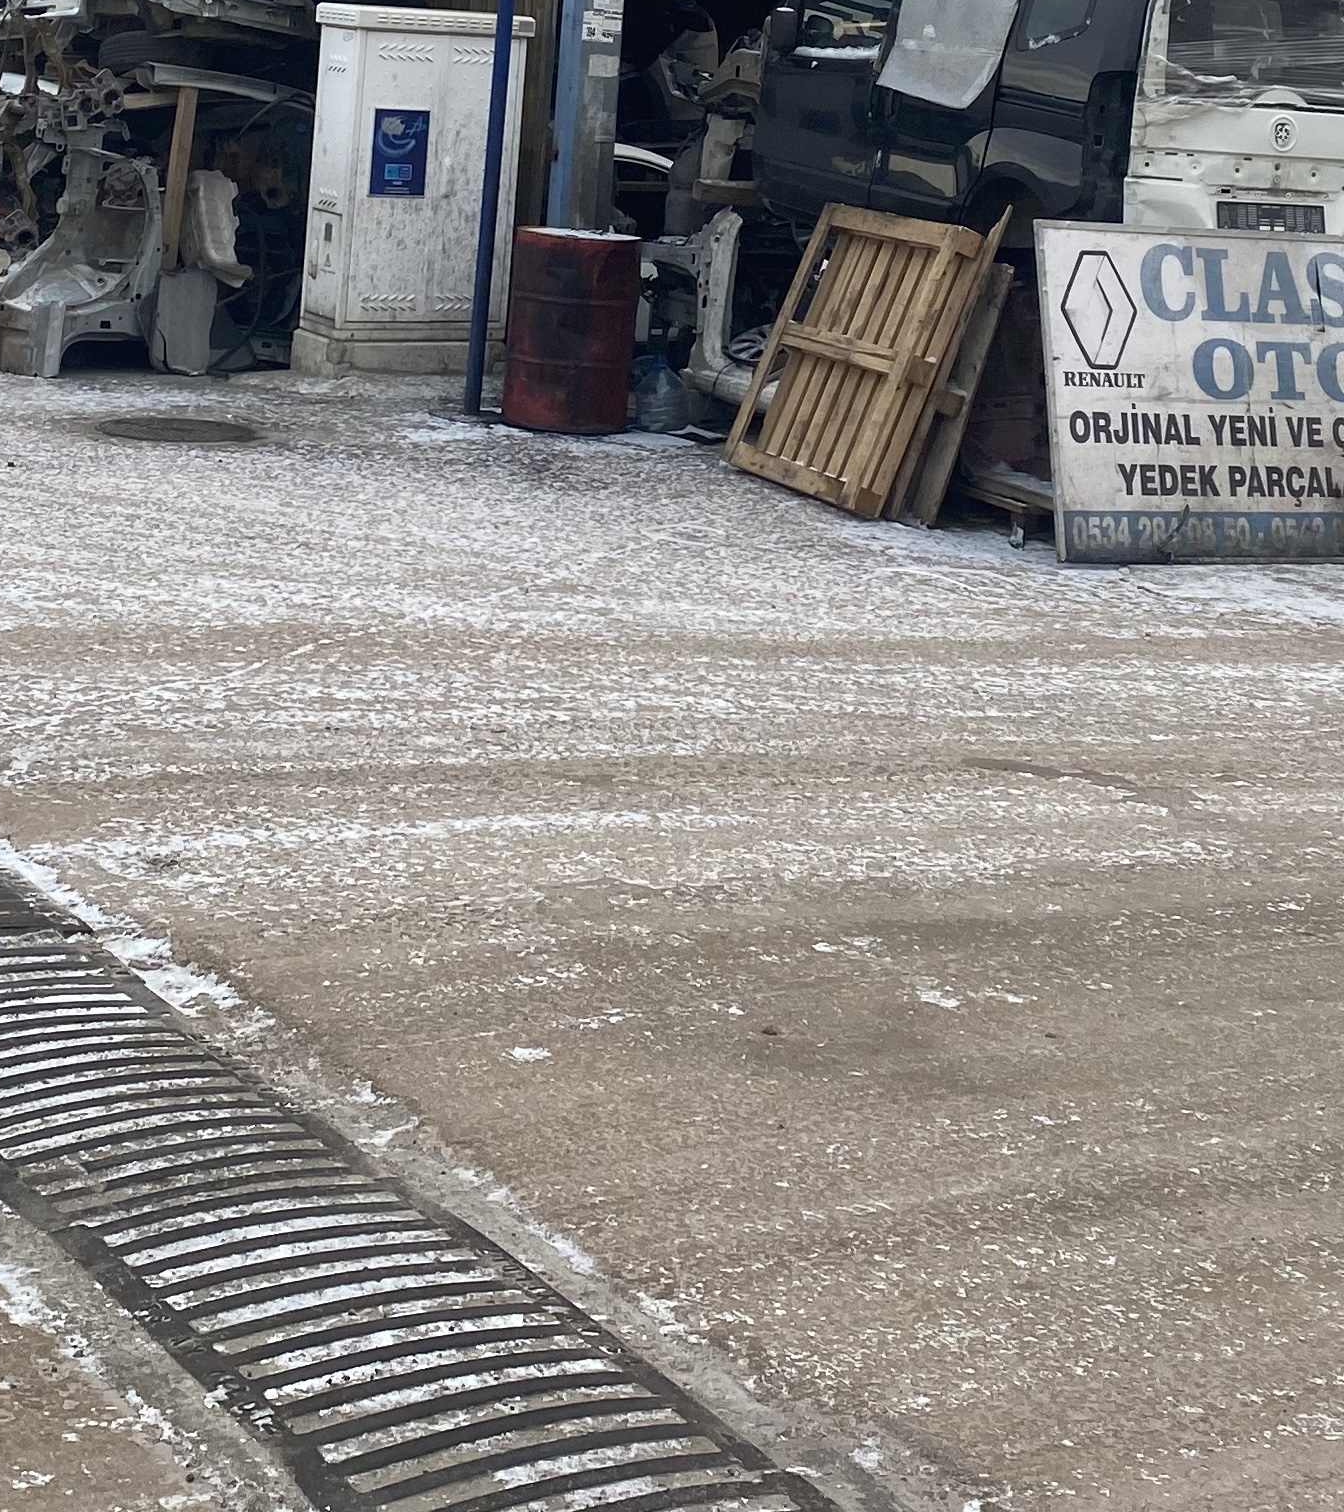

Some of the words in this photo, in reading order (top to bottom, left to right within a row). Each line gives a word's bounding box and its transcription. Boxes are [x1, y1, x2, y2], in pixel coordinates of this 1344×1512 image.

[1062, 370, 1146, 389] RENAULT
[1069, 402, 1201, 446] ORJİNAL
[1208, 406, 1277, 448] YENİ
[1286, 416, 1322, 447] VE
[1117, 462, 1221, 498] YEDEK
[1072, 514, 1132, 549] 0534
[1222, 516, 1251, 549] 50
